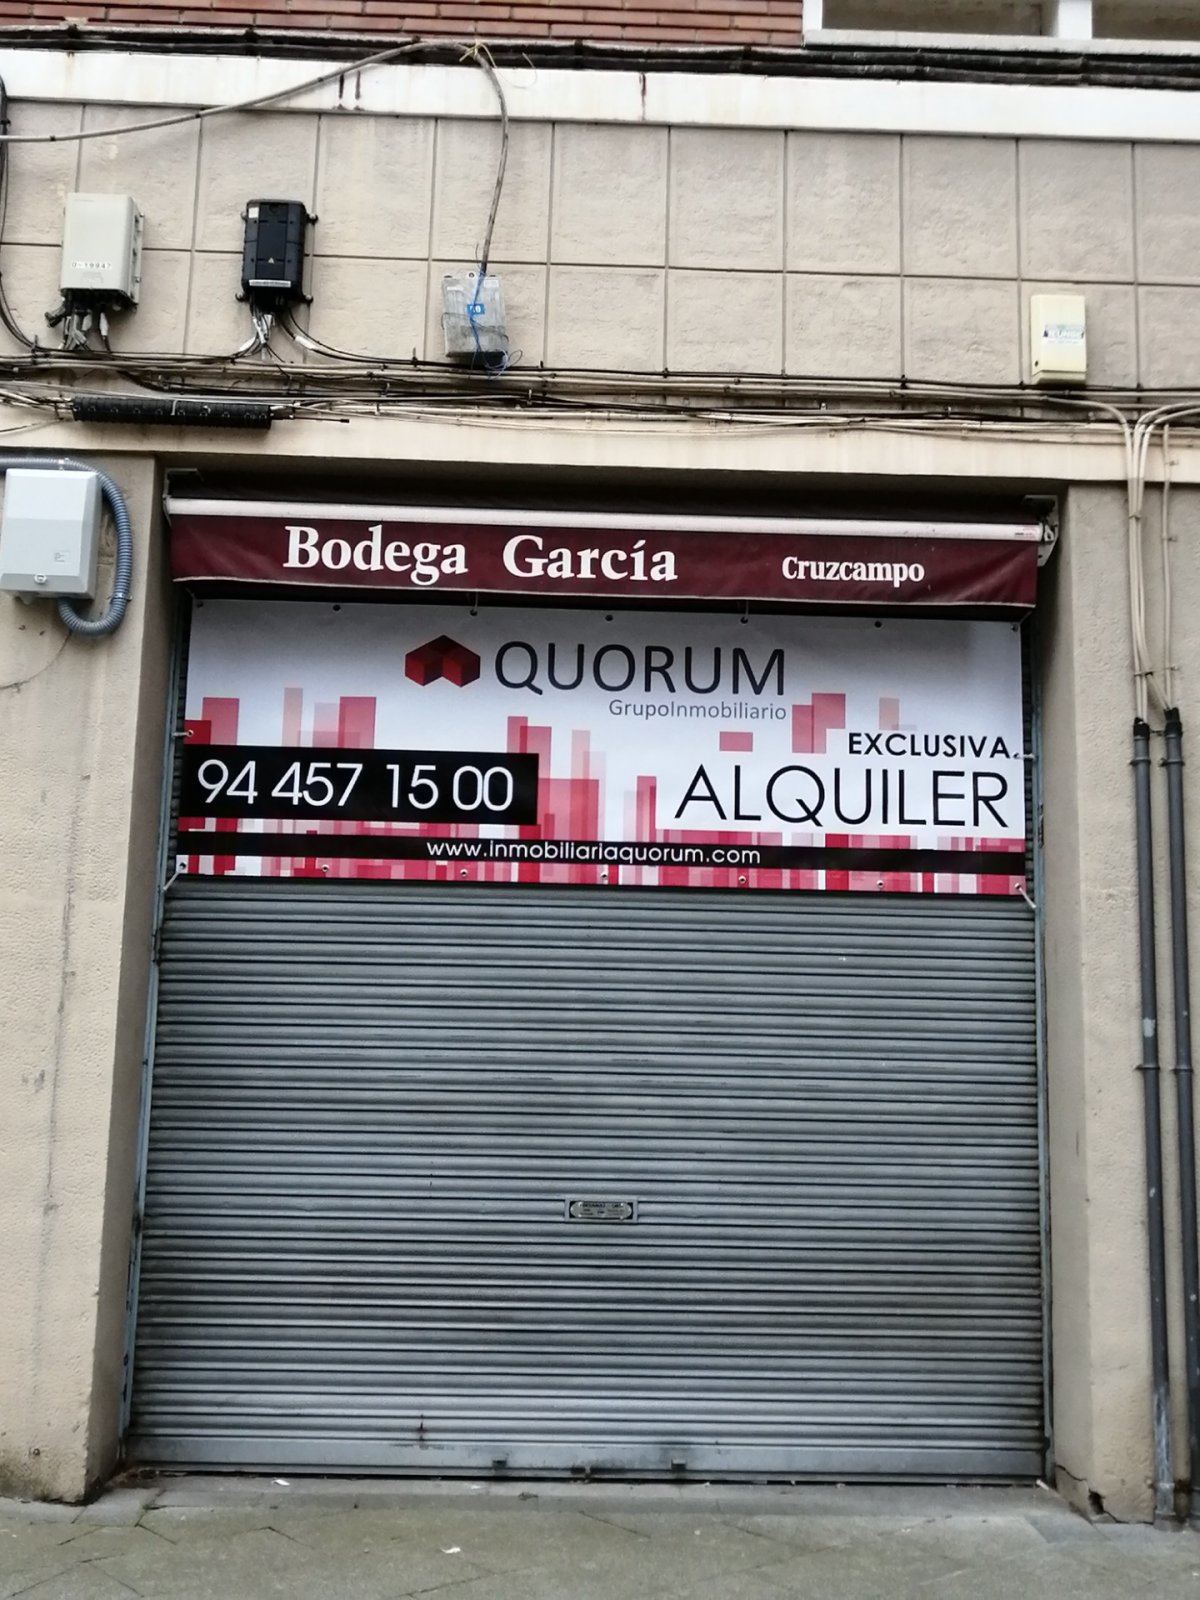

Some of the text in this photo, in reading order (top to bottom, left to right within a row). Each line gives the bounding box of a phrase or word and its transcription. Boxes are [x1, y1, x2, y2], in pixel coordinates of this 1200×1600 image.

[282, 524, 678, 586] Bodega García
[781, 555, 926, 588] Cruzcampo
[494, 640, 786, 696] QUORUM
[608, 699, 787, 721] GrupoInmobiliario
[848, 731, 1011, 759] EXCLUSIVA
[197, 758, 515, 812] 94 457 15 00
[673, 763, 1009, 829] ALQUILER
[425, 839, 762, 866] www.inmobiliariaquorum.com
